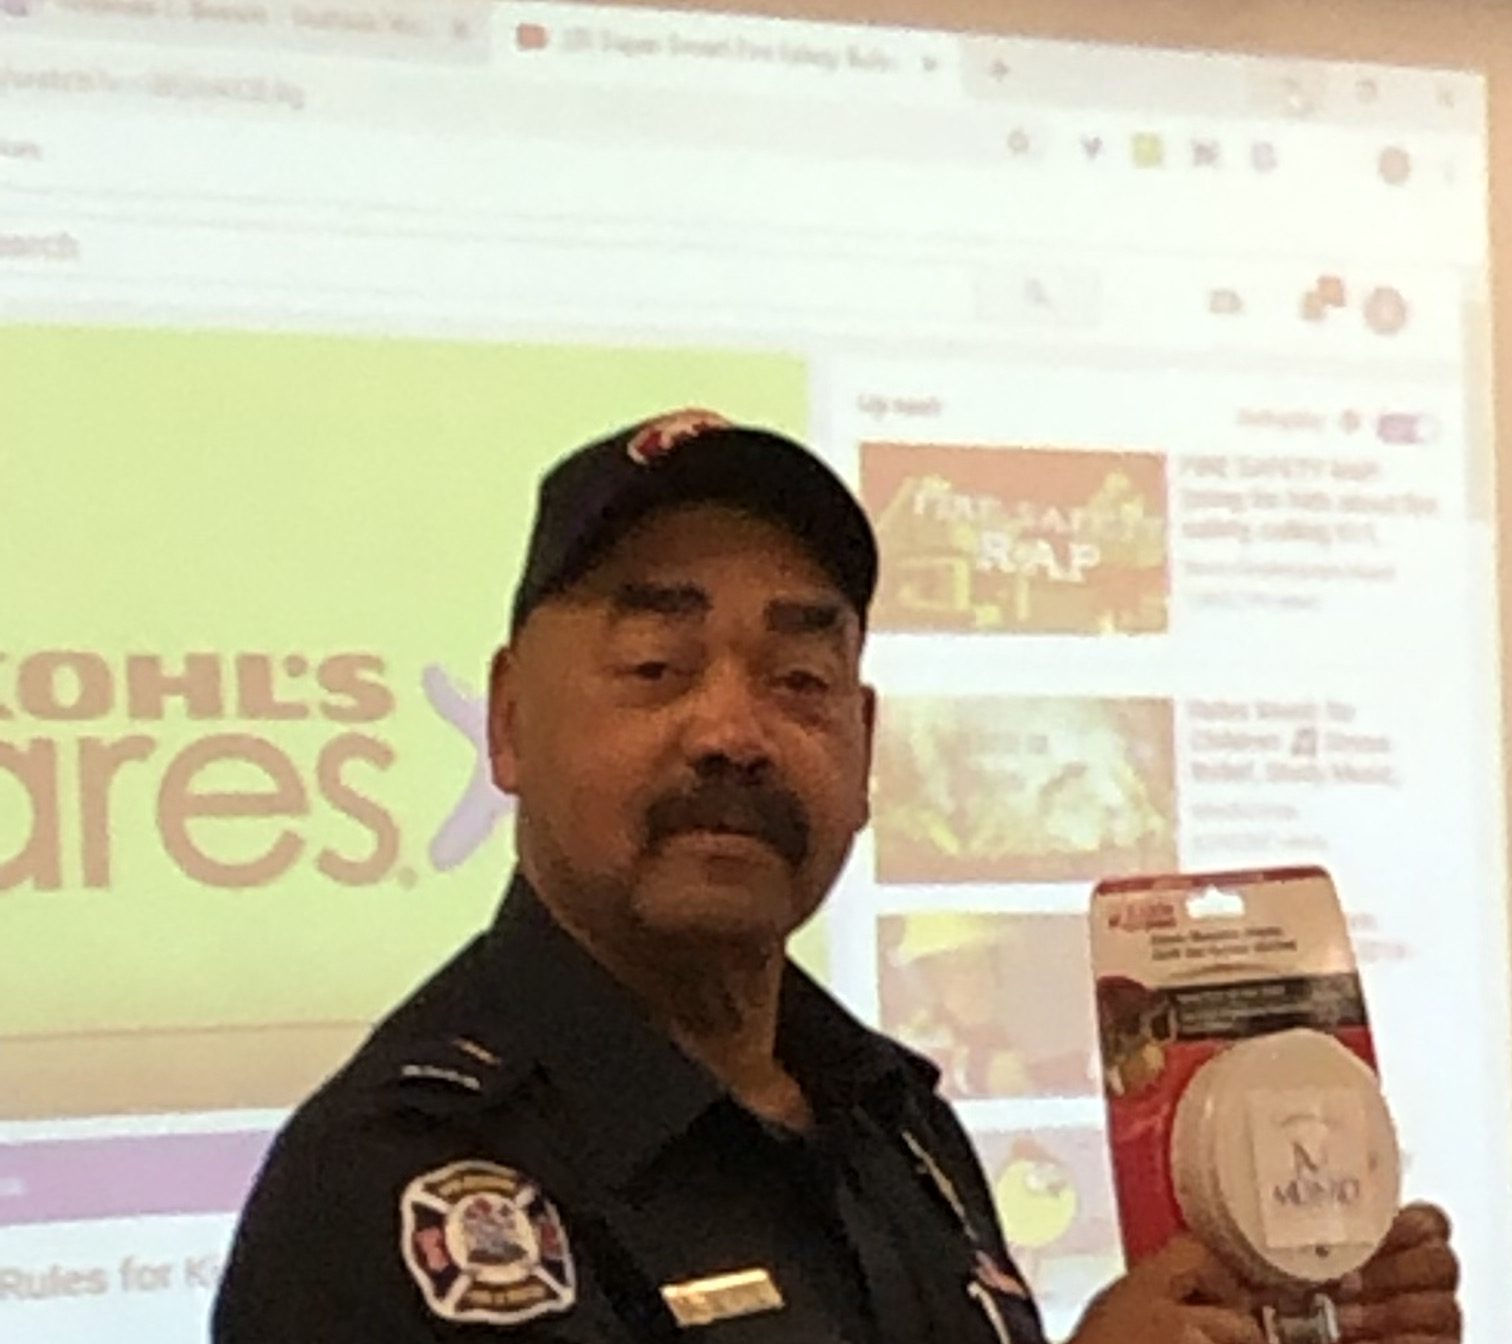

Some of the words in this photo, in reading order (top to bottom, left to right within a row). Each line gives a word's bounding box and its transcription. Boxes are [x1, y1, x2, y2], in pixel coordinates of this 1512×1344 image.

[974, 529, 1102, 582] RAP
[0, 649, 397, 723] OHL'S
[118, 1254, 171, 1294] for
